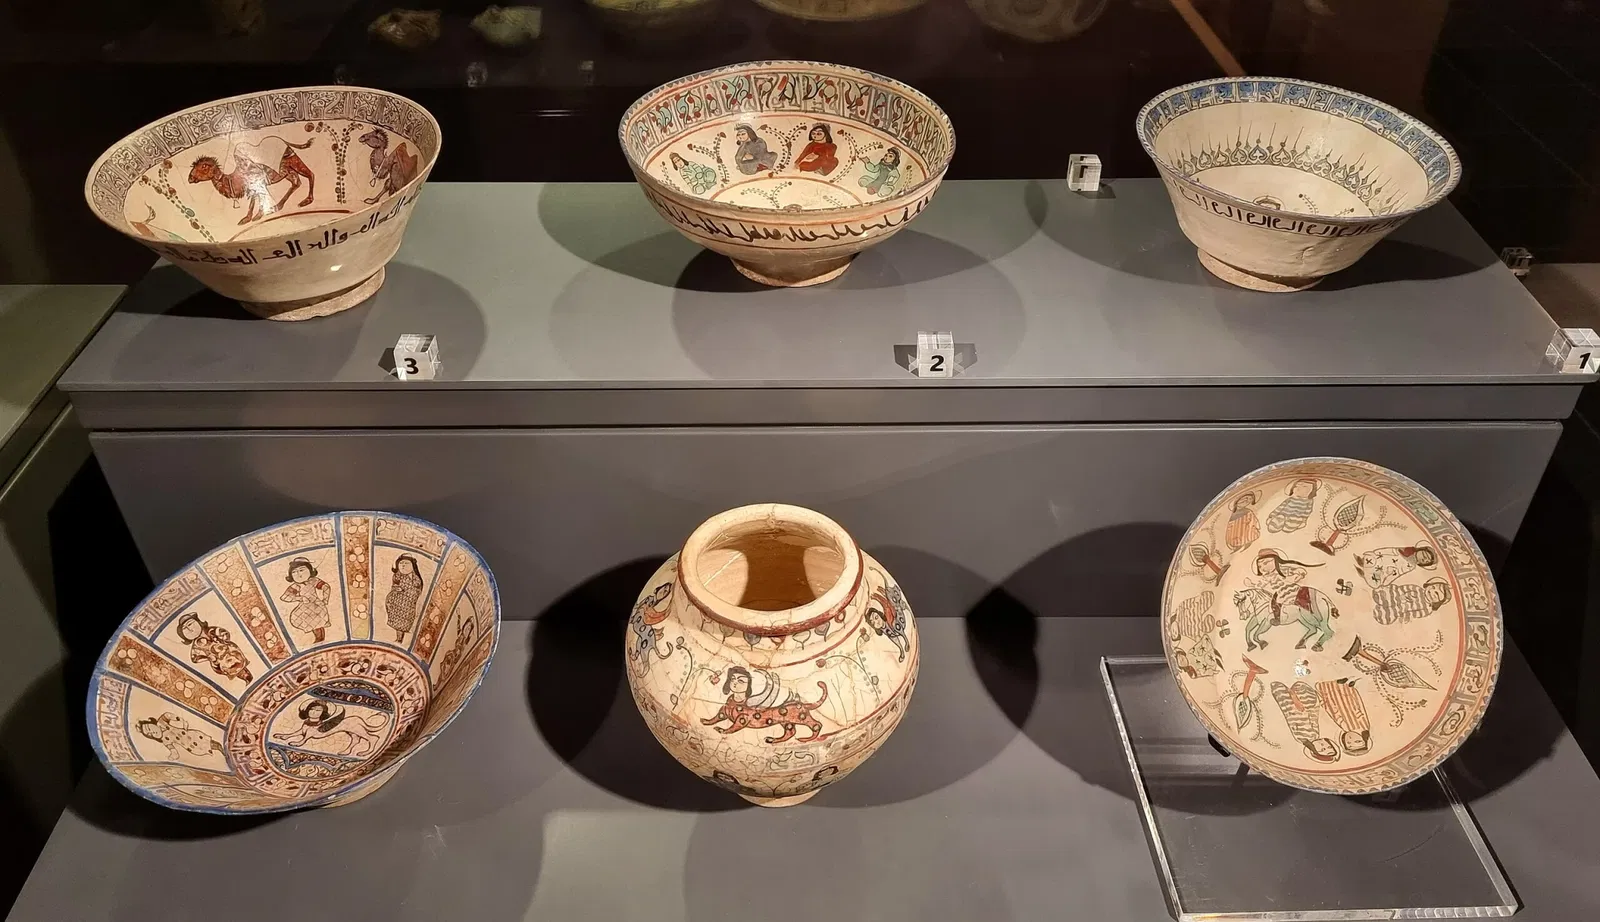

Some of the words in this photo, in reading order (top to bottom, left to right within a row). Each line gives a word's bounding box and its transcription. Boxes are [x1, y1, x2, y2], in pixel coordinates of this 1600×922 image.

[404, 357, 420, 375] 3
[929, 354, 945, 372] 2
[1579, 352, 1592, 370] 1
